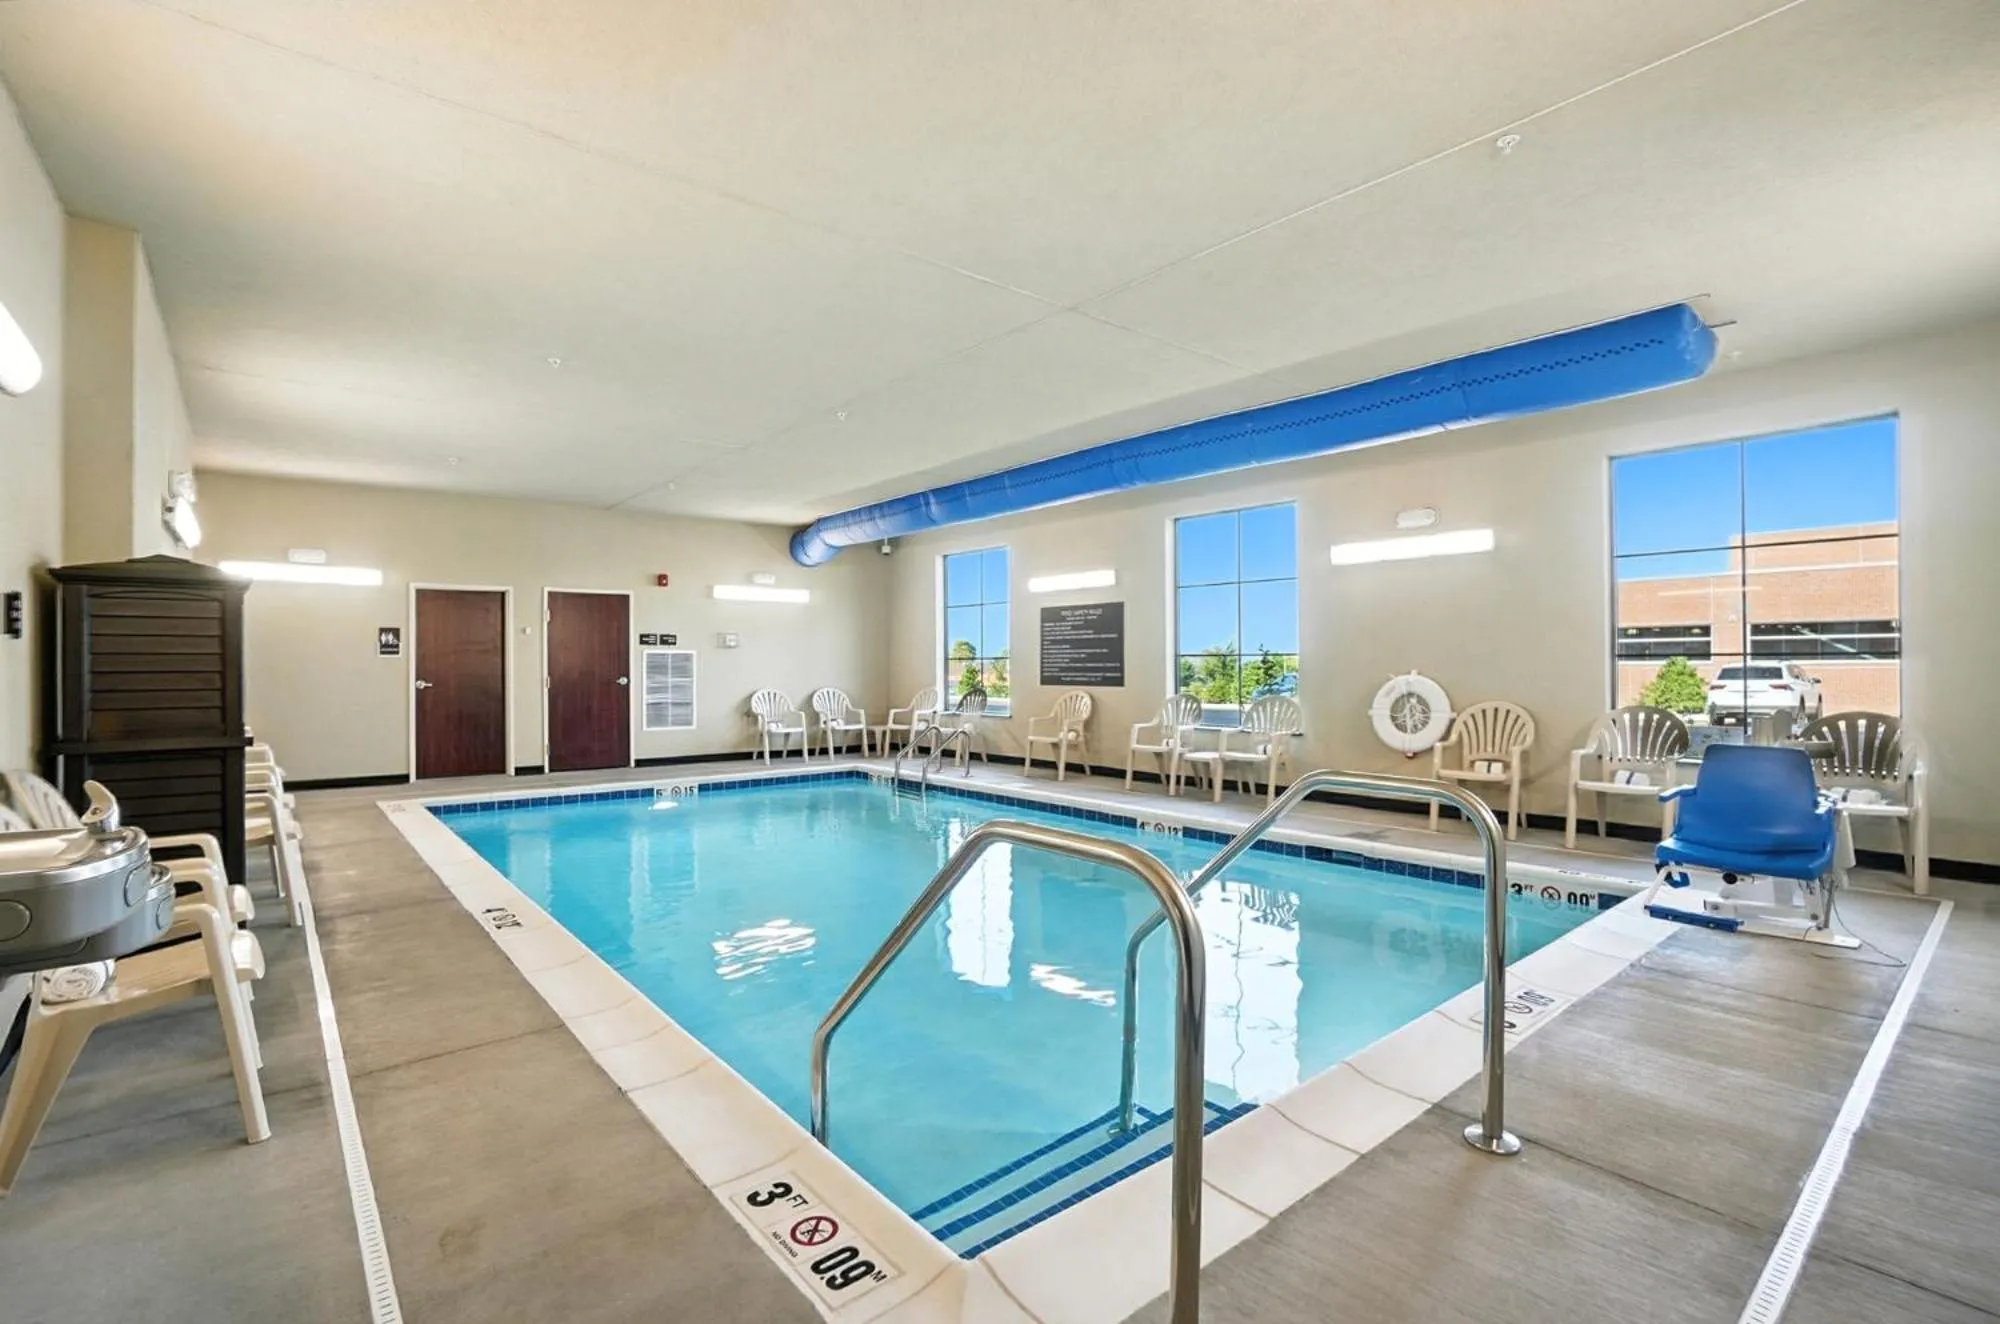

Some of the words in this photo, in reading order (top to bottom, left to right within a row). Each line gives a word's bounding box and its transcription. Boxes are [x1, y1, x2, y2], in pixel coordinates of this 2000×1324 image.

[746, 1182, 793, 1208] 3
[786, 1193, 809, 1209] FT
[779, 1240, 798, 1257] DIVING
[810, 1245, 876, 1291] 0.9
[870, 1270, 888, 1284] M
